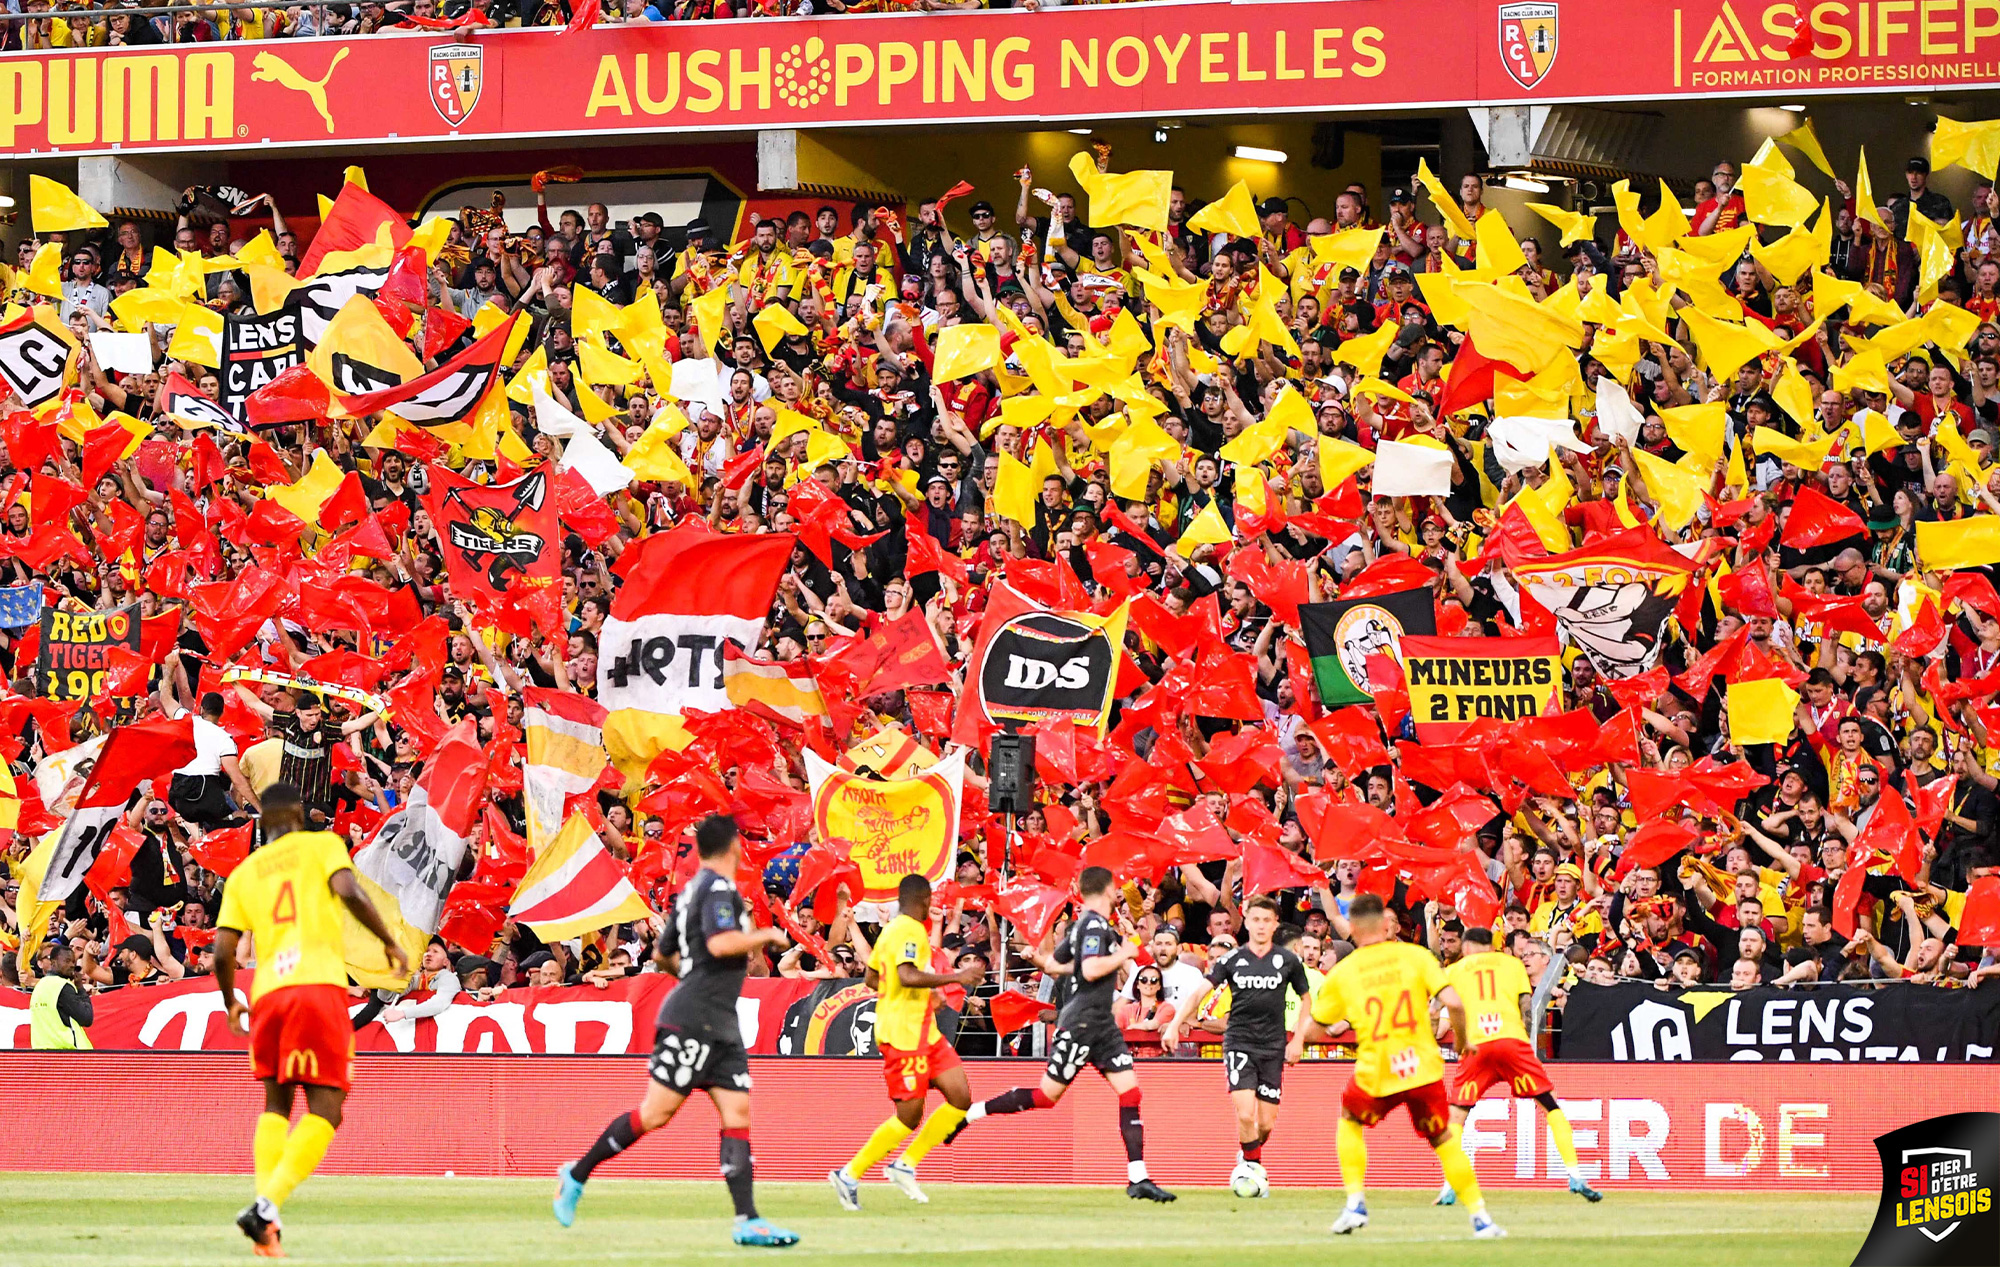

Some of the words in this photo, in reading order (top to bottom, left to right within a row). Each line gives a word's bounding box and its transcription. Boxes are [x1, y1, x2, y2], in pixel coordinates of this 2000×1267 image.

[1061, 26, 1386, 88] NOYELLES
[1692, 67, 1811, 87] FORMATION
[1818, 61, 2000, 82] PROFESSIONNELL
[229, 315, 296, 351] LENS
[459, 535, 532, 551] TIGERS
[50, 611, 107, 643] RED
[1004, 653, 1090, 689] IDS
[1409, 658, 1552, 686] MINEURS
[1430, 694, 1449, 721] 2
[1458, 694, 1537, 722] FOND
[272, 880, 297, 926] 4
[1474, 969, 1497, 1001] 11
[1365, 990, 1417, 1042] 24
[1726, 997, 1875, 1045] LENS
[678, 1038, 711, 1072] 31
[901, 1055, 928, 1076] 28
[1067, 1043, 1090, 1066] 12
[1227, 1050, 1249, 1071] 17
[1462, 1098, 1671, 1179] FIER
[1704, 1102, 1830, 1177] DE
